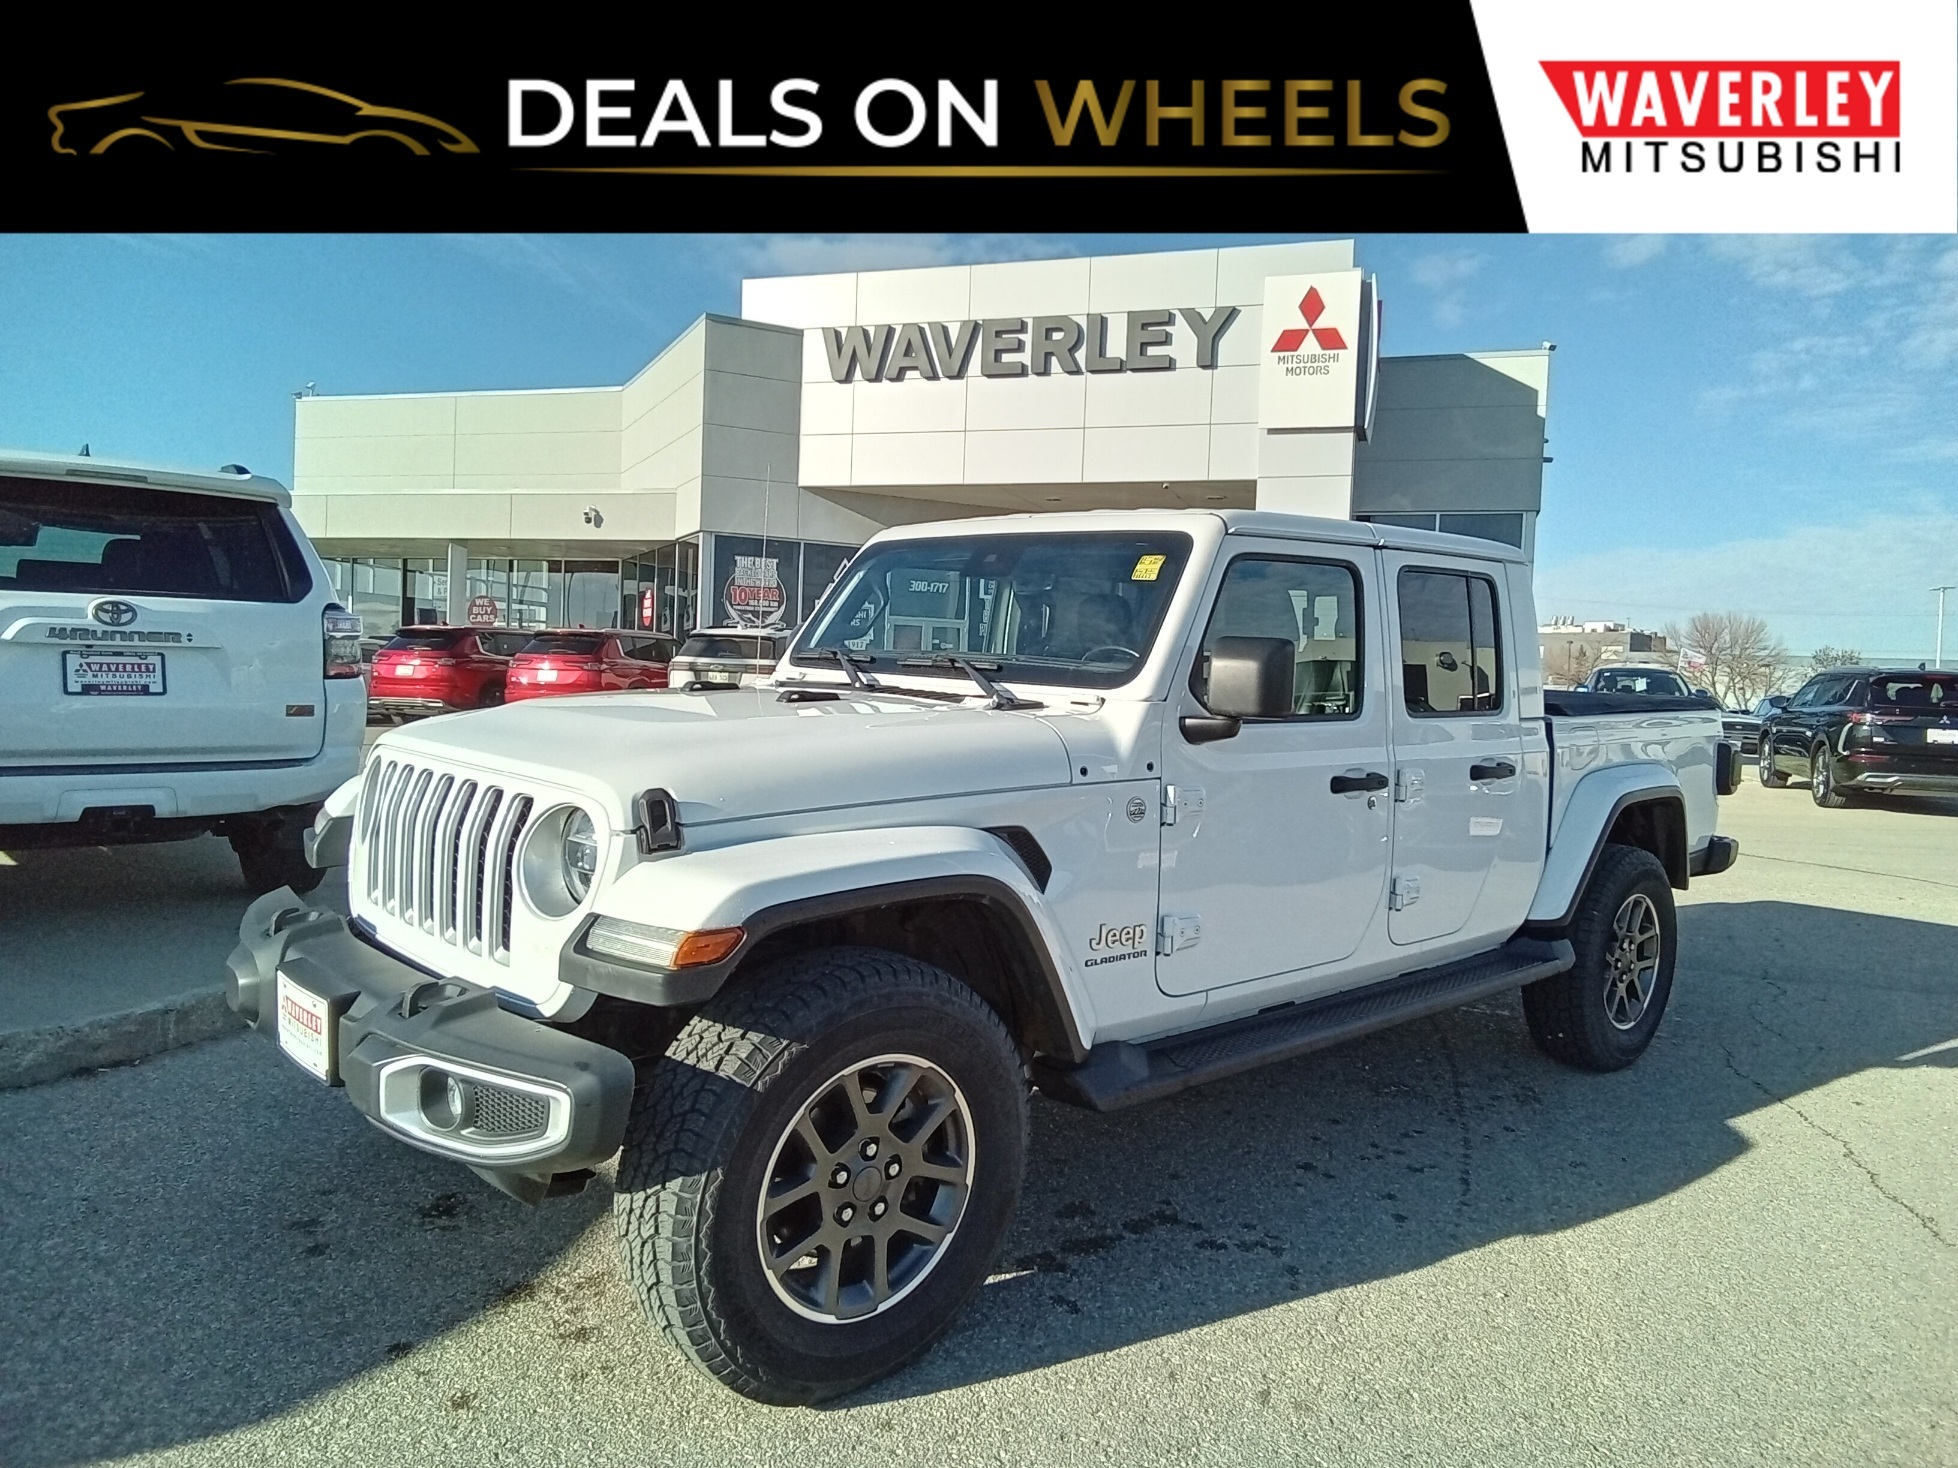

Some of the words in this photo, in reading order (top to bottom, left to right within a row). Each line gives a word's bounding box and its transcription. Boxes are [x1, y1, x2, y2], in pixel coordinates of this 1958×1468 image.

[822, 306, 1241, 383] WAVERLEY
[1277, 353, 1340, 365] MITSUBISHI
[1285, 365, 1330, 377] MOTORS
[735, 555, 754, 568] THE
[909, 580, 949, 594] 300-1717
[474, 598, 490, 606] WE
[731, 586, 748, 605] 10
[748, 588, 779, 600] YEAR
[472, 606, 493, 614] BUY
[469, 614, 495, 623] CARS
[90, 663, 155, 672] WAVERLEY
[1089, 924, 1147, 951] Jeep
[1084, 950, 1148, 968] GLADIATOR
[287, 998, 321, 1034] WAVERLEY
[288, 1018, 322, 1046] MITSUBISHI
